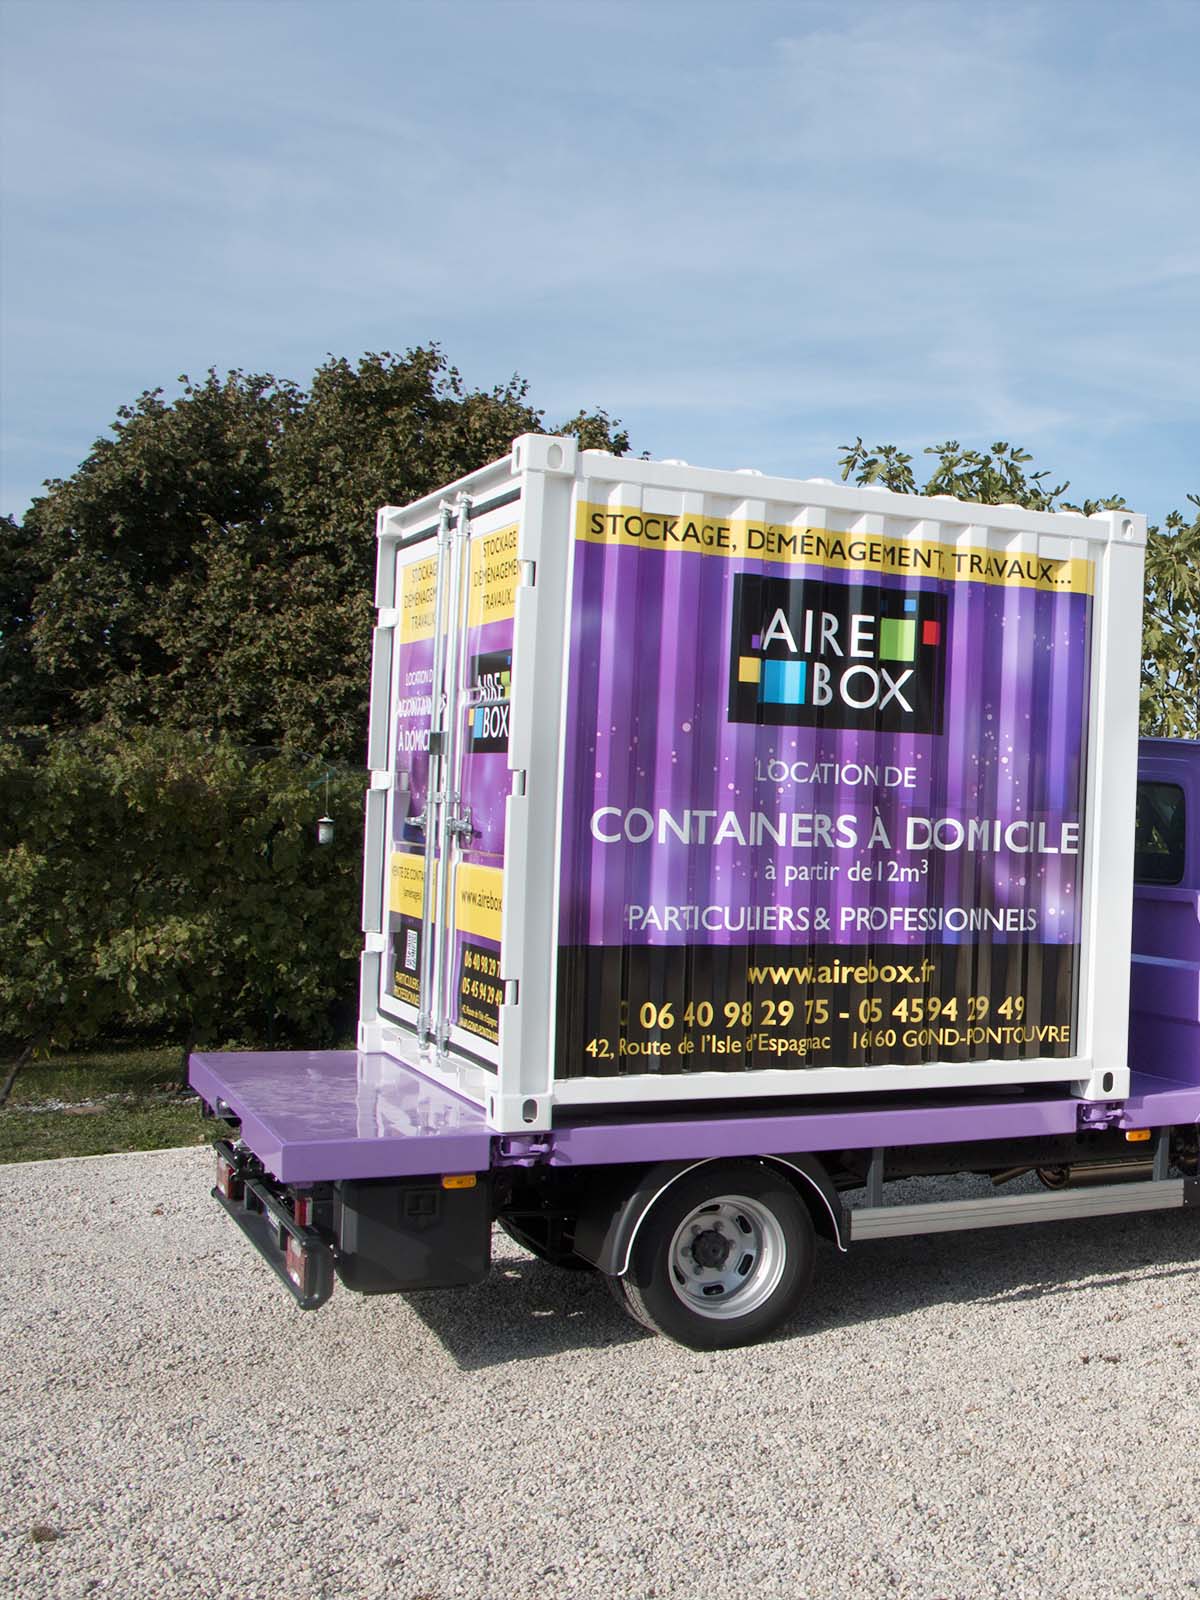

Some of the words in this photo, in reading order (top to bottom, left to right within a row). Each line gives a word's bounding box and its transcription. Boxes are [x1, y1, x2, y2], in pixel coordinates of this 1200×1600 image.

[590, 511, 738, 552] STOCKAGE,
[747, 525, 945, 574] DÉMÉNAGEMENT,
[951, 552, 1072, 584] TRAVAUX...
[473, 558, 522, 588] DÉMÉNAGEMEN
[761, 607, 876, 659] AIRE
[478, 672, 504, 701] AIRE
[812, 661, 915, 713] BOX
[482, 705, 509, 738] BOX
[756, 760, 879, 786] LOCATION
[884, 766, 917, 788] DE
[589, 806, 858, 849] CONTAINERS
[868, 806, 892, 849] À
[906, 816, 1080, 855] DOMICILE
[765, 858, 776, 881] à
[784, 861, 840, 888] partir
[847, 861, 872, 882] de
[628, 904, 810, 932] PARTICULIERS
[813, 906, 831, 931] &
[840, 906, 1037, 932] PROFESSIONNELS
[748, 958, 937, 986] www.airebox.fr
[639, 1002, 675, 1030] 06
[683, 1001, 714, 1028] 40
[723, 1001, 752, 1029] 98
[760, 1000, 794, 1027] 29
[804, 999, 829, 1025] 75
[858, 998, 882, 1025] 05
[892, 996, 924, 1023] 45
[927, 997, 959, 1023] 94
[967, 995, 990, 1022] 29
[997, 995, 1024, 1021] 49
[586, 1037, 615, 1060] 42,
[618, 1036, 672, 1057] Route
[678, 1034, 694, 1054] de
[852, 1029, 897, 1050] 16160
[902, 1025, 1070, 1048] GOND-PONTOUVRE
